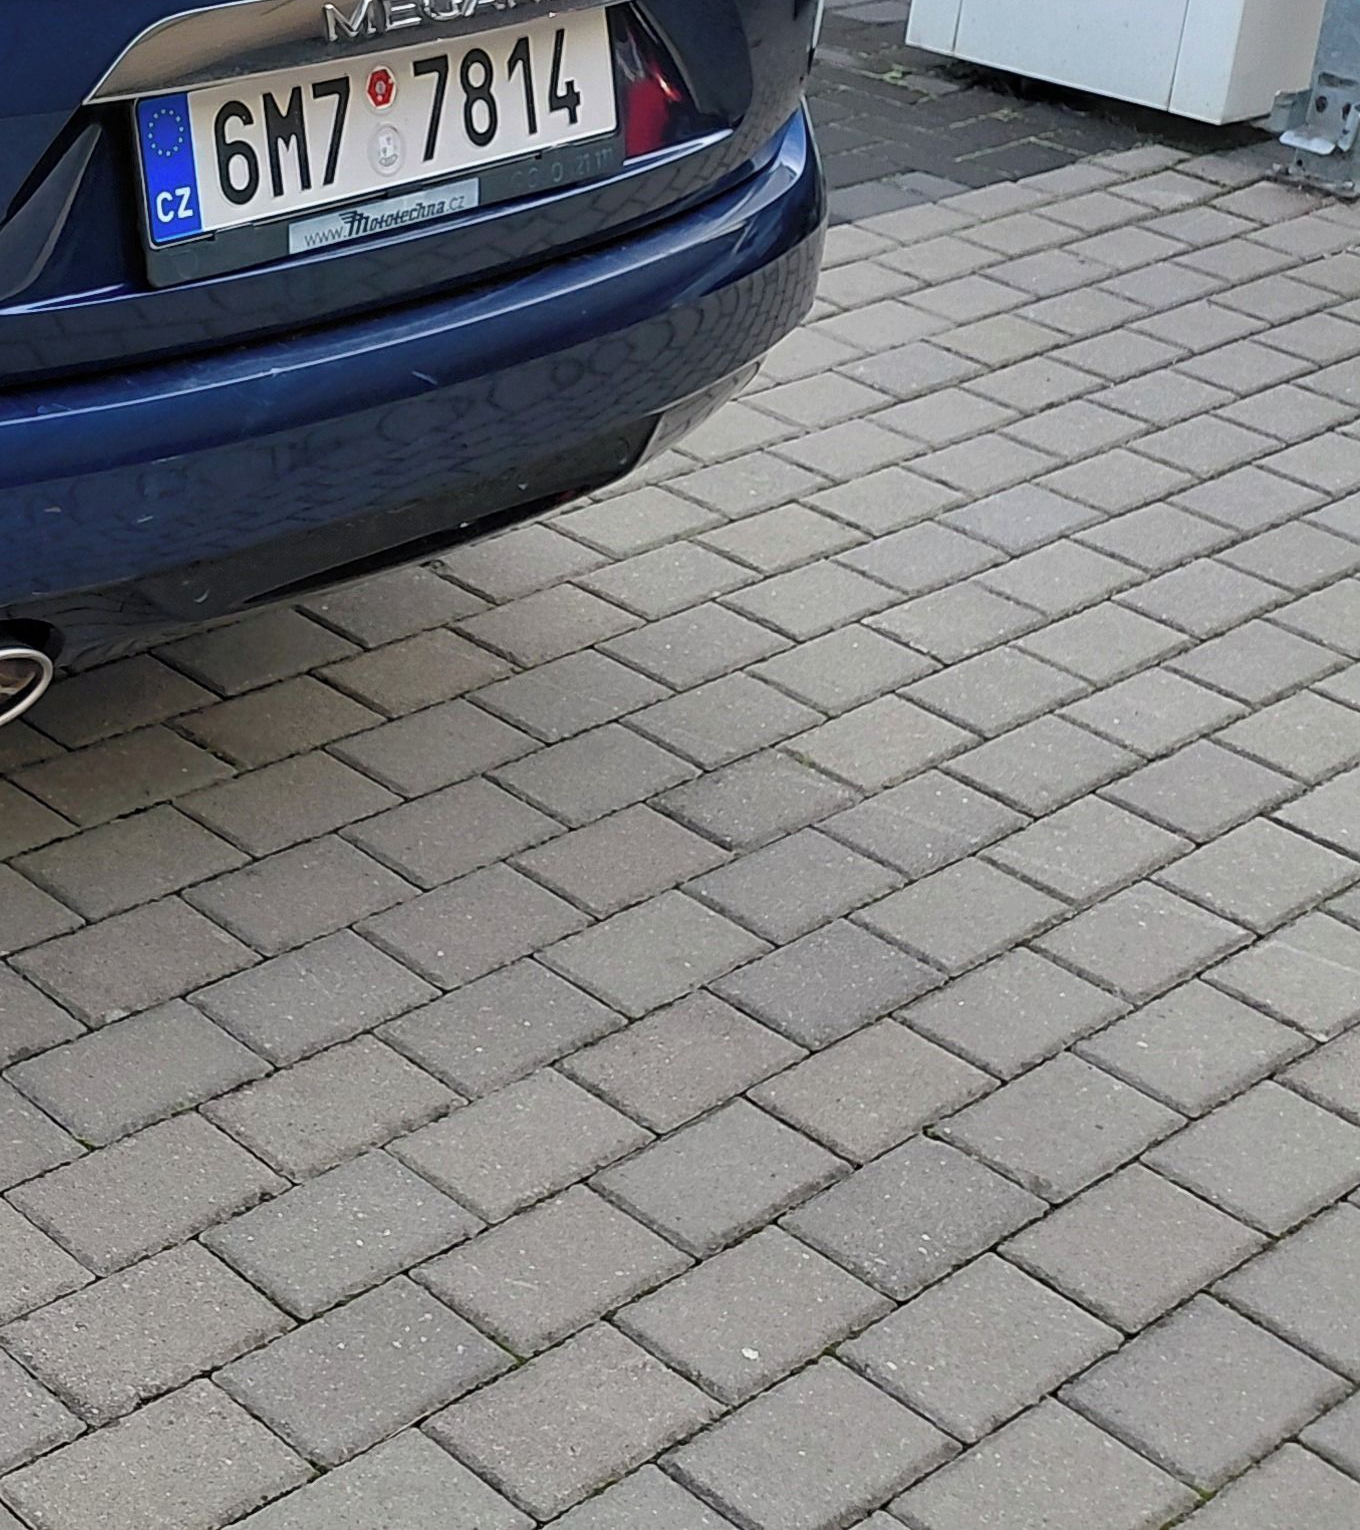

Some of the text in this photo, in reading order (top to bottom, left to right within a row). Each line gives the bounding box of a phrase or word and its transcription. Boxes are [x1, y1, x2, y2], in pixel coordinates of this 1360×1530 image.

[213, 28, 582, 206] 6M7 7814
[155, 186, 194, 223] CZ
[304, 195, 466, 247] www.Mototechna.cz
